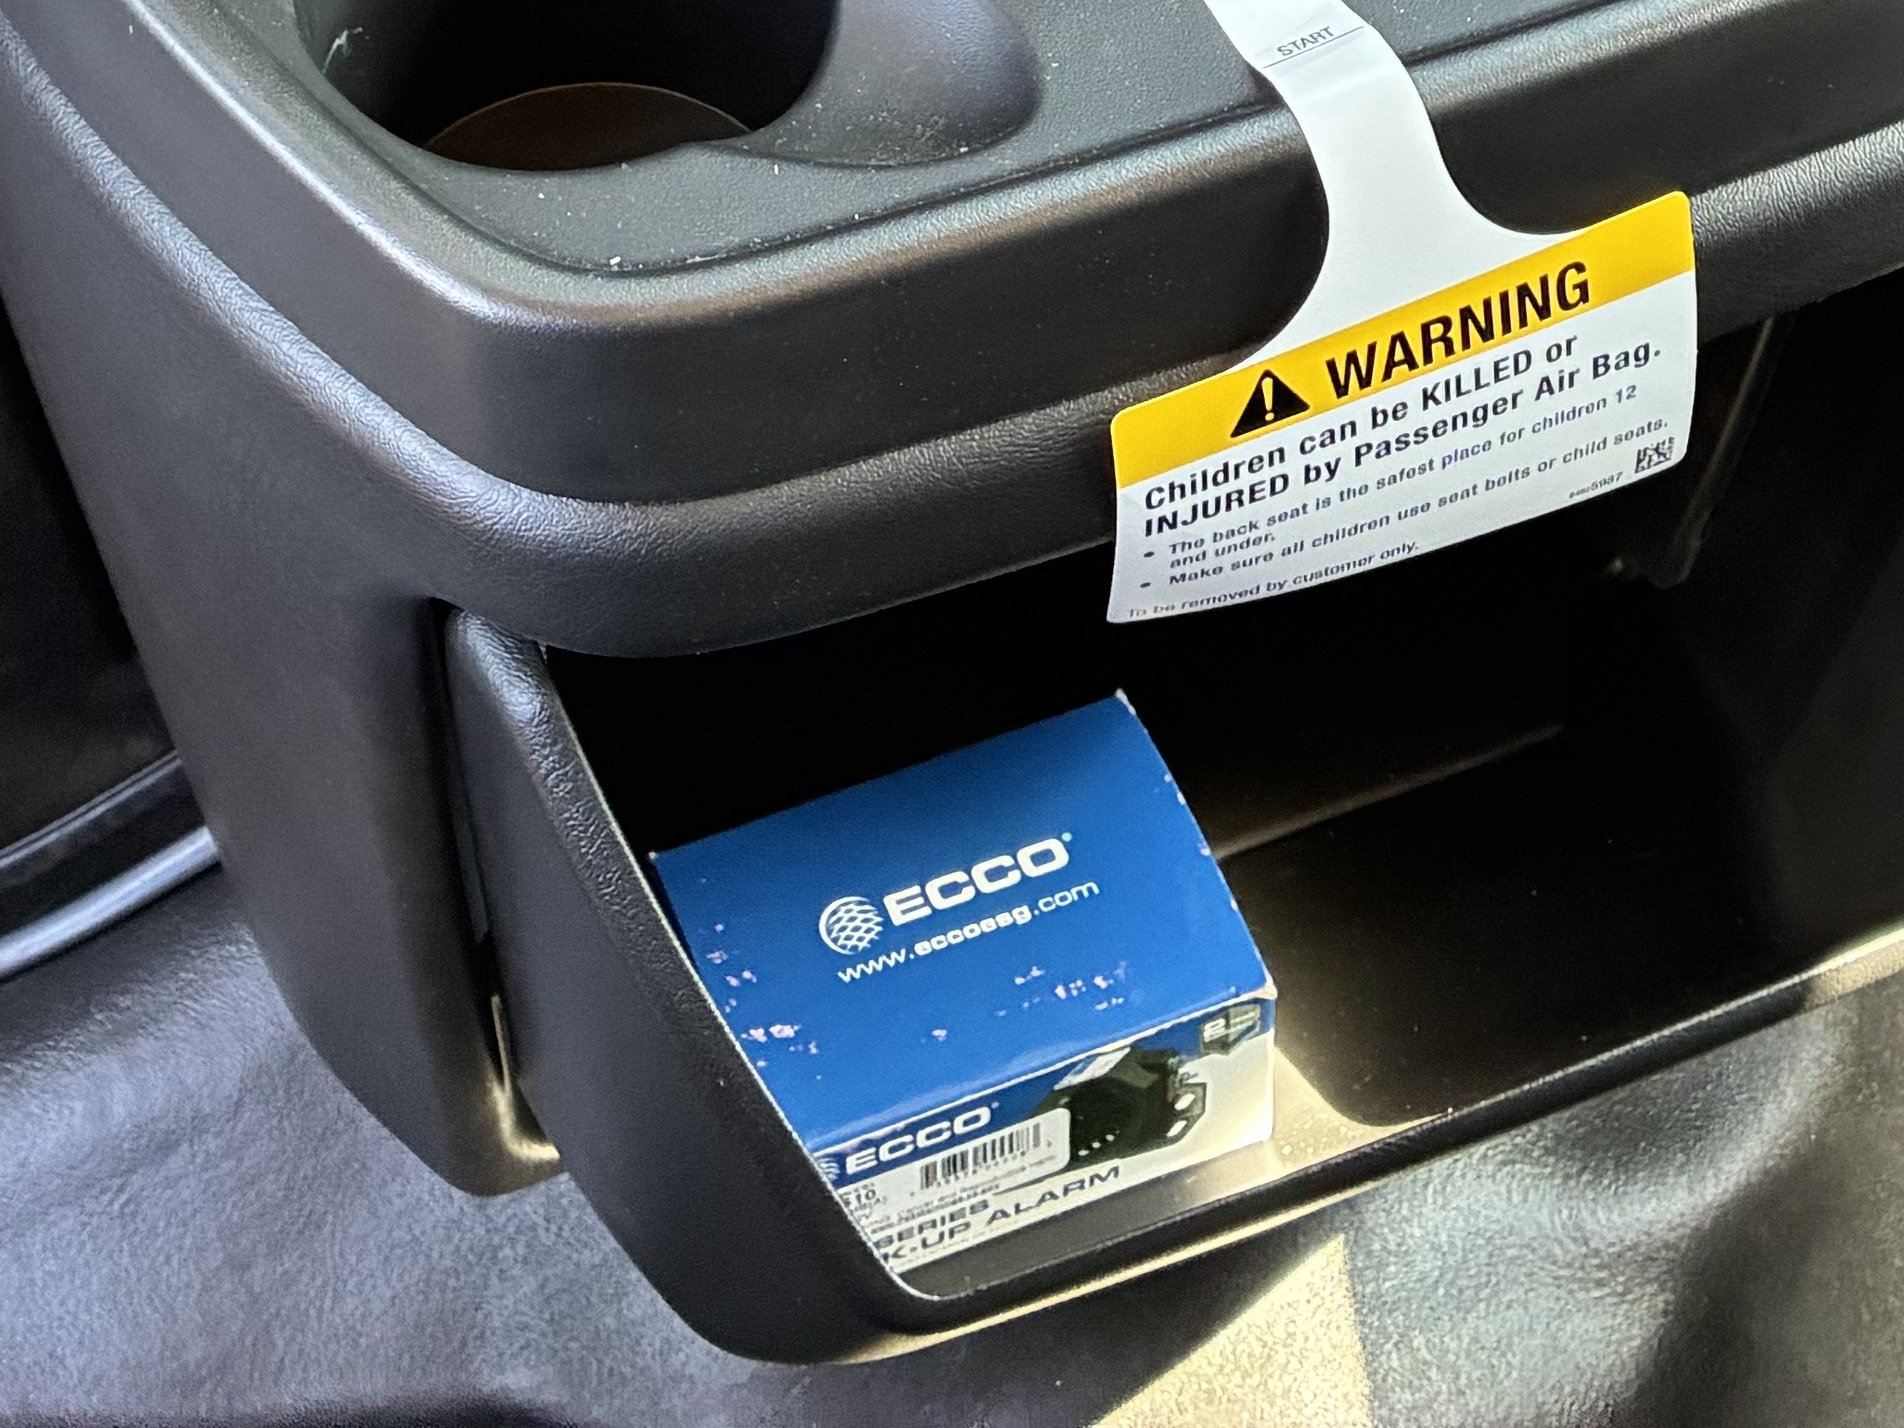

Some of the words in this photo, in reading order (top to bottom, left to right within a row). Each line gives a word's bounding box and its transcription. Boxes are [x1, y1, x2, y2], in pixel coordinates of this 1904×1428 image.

[1277, 26, 1334, 56] START
[1325, 261, 1590, 399] WARNING
[1145, 446, 1286, 510] Children
[1299, 420, 1357, 455] can
[1371, 401, 1409, 430] be
[1421, 348, 1532, 411] KILLED
[1545, 335, 1578, 363] or
[1145, 473, 1289, 537] INJURED
[1304, 456, 1342, 485] by
[1354, 389, 1524, 467] Passenger
[1534, 368, 1580, 401] Air
[1592, 342, 1661, 380] Bag.
[1168, 536, 1205, 555] The
[1212, 520, 1259, 543] back
[1266, 503, 1309, 527] seat
[1315, 496, 1332, 510] is
[1338, 484, 1369, 503] the
[1376, 457, 1435, 490] safest
[1441, 440, 1492, 469] place
[1499, 426, 1526, 446] for
[1532, 398, 1607, 434] children
[1615, 384, 1637, 404] 12
[1169, 565, 1224, 585] Make
[1231, 553, 1274, 571] sure
[1280, 541, 1305, 557] all
[1311, 514, 1391, 548] children
[1398, 501, 1431, 521] use
[1438, 485, 1478, 508] seat
[1485, 465, 1531, 492] belts
[1537, 457, 1557, 473] or
[1562, 436, 1608, 464] child
[1613, 419, 1669, 446] seats.
[1169, 549, 1207, 569] and
[1181, 584, 1261, 610] removed
[1266, 578, 1288, 593] by
[1293, 556, 1376, 586] customer
[1380, 541, 1419, 561] only.
[882, 838, 1070, 926] ECCO
[837, 882, 1100, 983] www.eccoesg.com
[846, 1106, 991, 1175] ECCO
[873, 1199, 990, 1249] SERIES
[882, 1221, 972, 1263] K-UP
[986, 1165, 1120, 1226] ALARM
